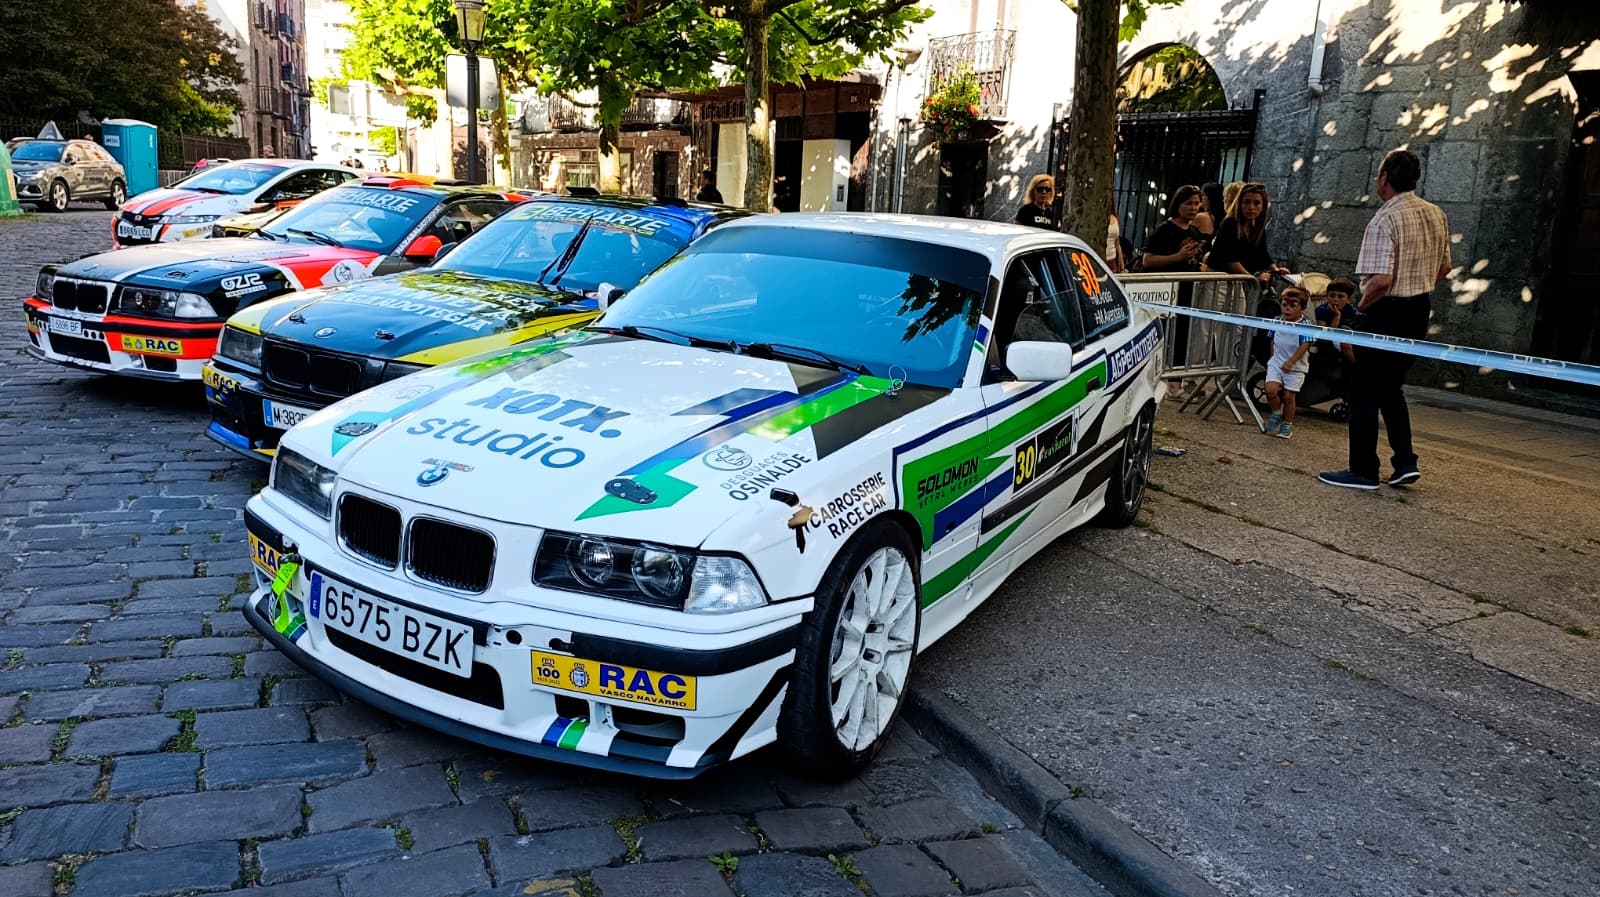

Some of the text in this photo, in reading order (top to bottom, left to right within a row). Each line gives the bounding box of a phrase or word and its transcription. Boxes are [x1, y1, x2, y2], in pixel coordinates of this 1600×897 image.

[543, 205, 672, 231] BEHIARTE
[1071, 252, 1101, 296] 30
[1128, 290, 1169, 302] ZKOITIKO
[144, 338, 179, 351] RAC
[406, 417, 586, 468] studio
[720, 450, 789, 490] DESGUACES
[729, 453, 812, 501] OSINALDE
[917, 456, 979, 499] SOLOMON
[1016, 445, 1035, 485] 30
[810, 471, 886, 529] CARROSSERIE
[828, 492, 887, 539] RACE CAR
[325, 586, 391, 642] 6575
[403, 615, 464, 669] BZK
[536, 666, 560, 679] 100
[600, 663, 687, 699] RAC
[600, 689, 687, 707] VASCO NAVARRO
